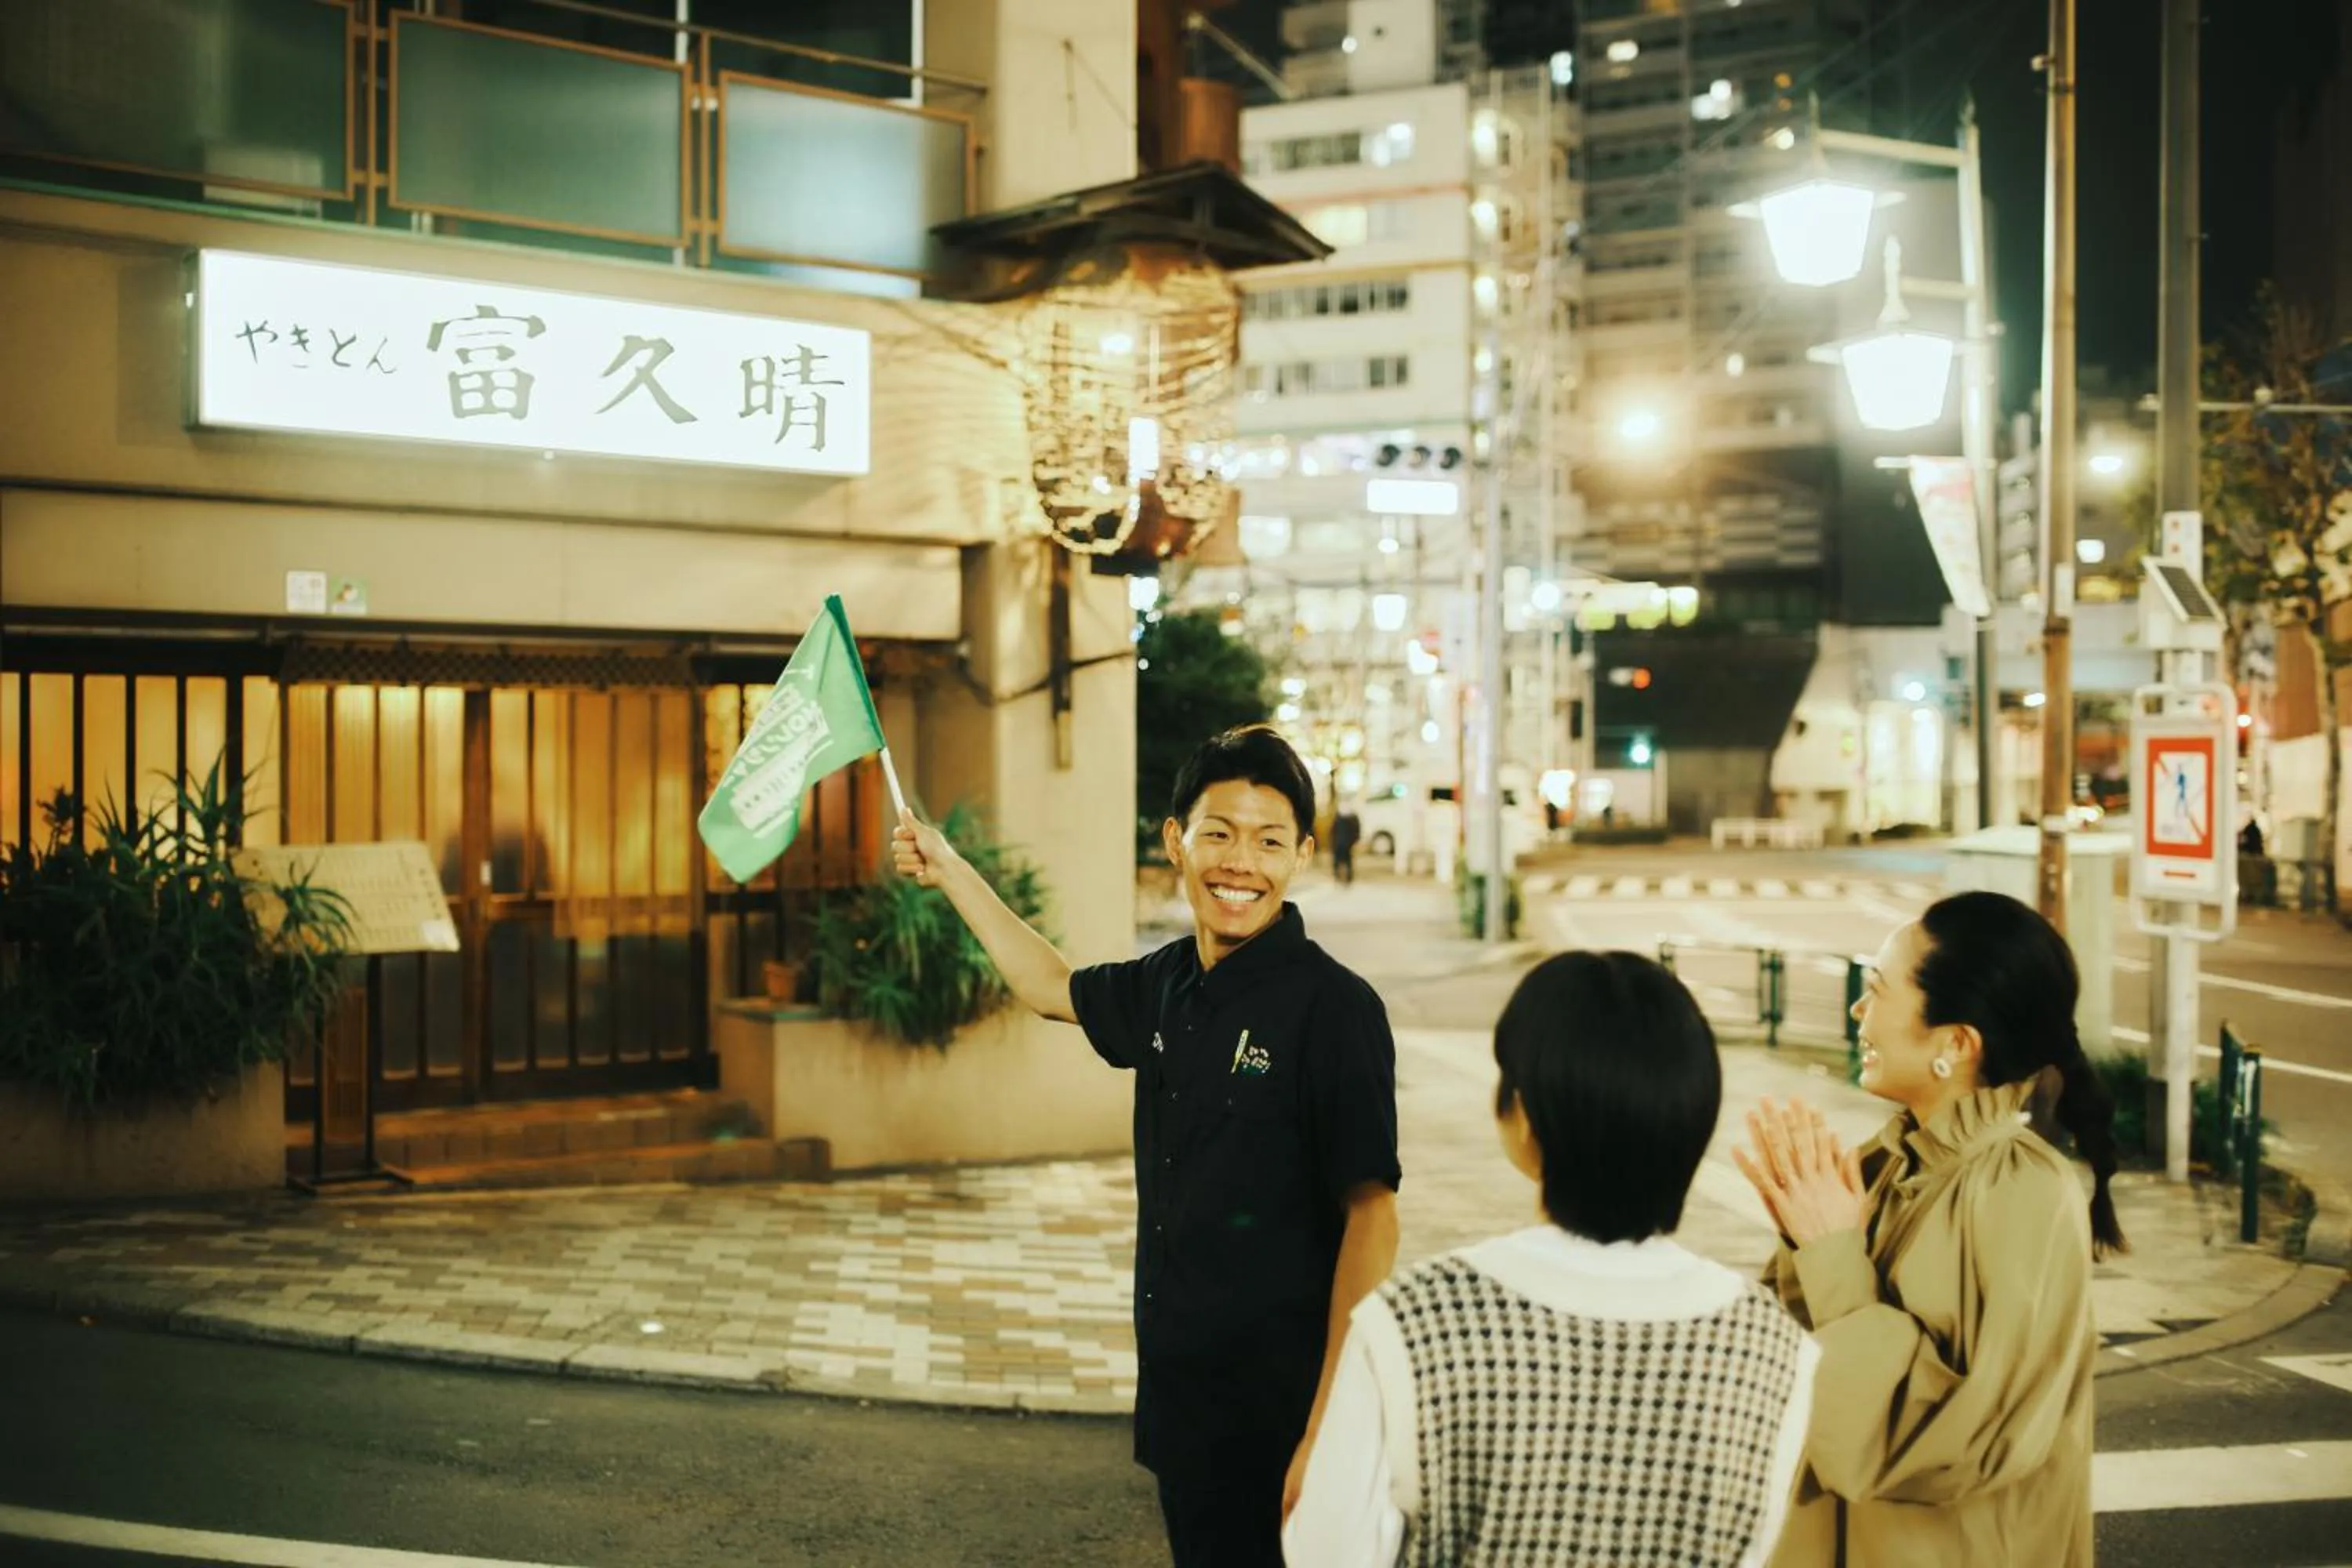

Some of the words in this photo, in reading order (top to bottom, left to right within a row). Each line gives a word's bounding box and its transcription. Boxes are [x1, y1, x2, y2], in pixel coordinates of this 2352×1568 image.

[235, 320, 397, 374] やきとん
[426, 304, 845, 452] 富久晴
